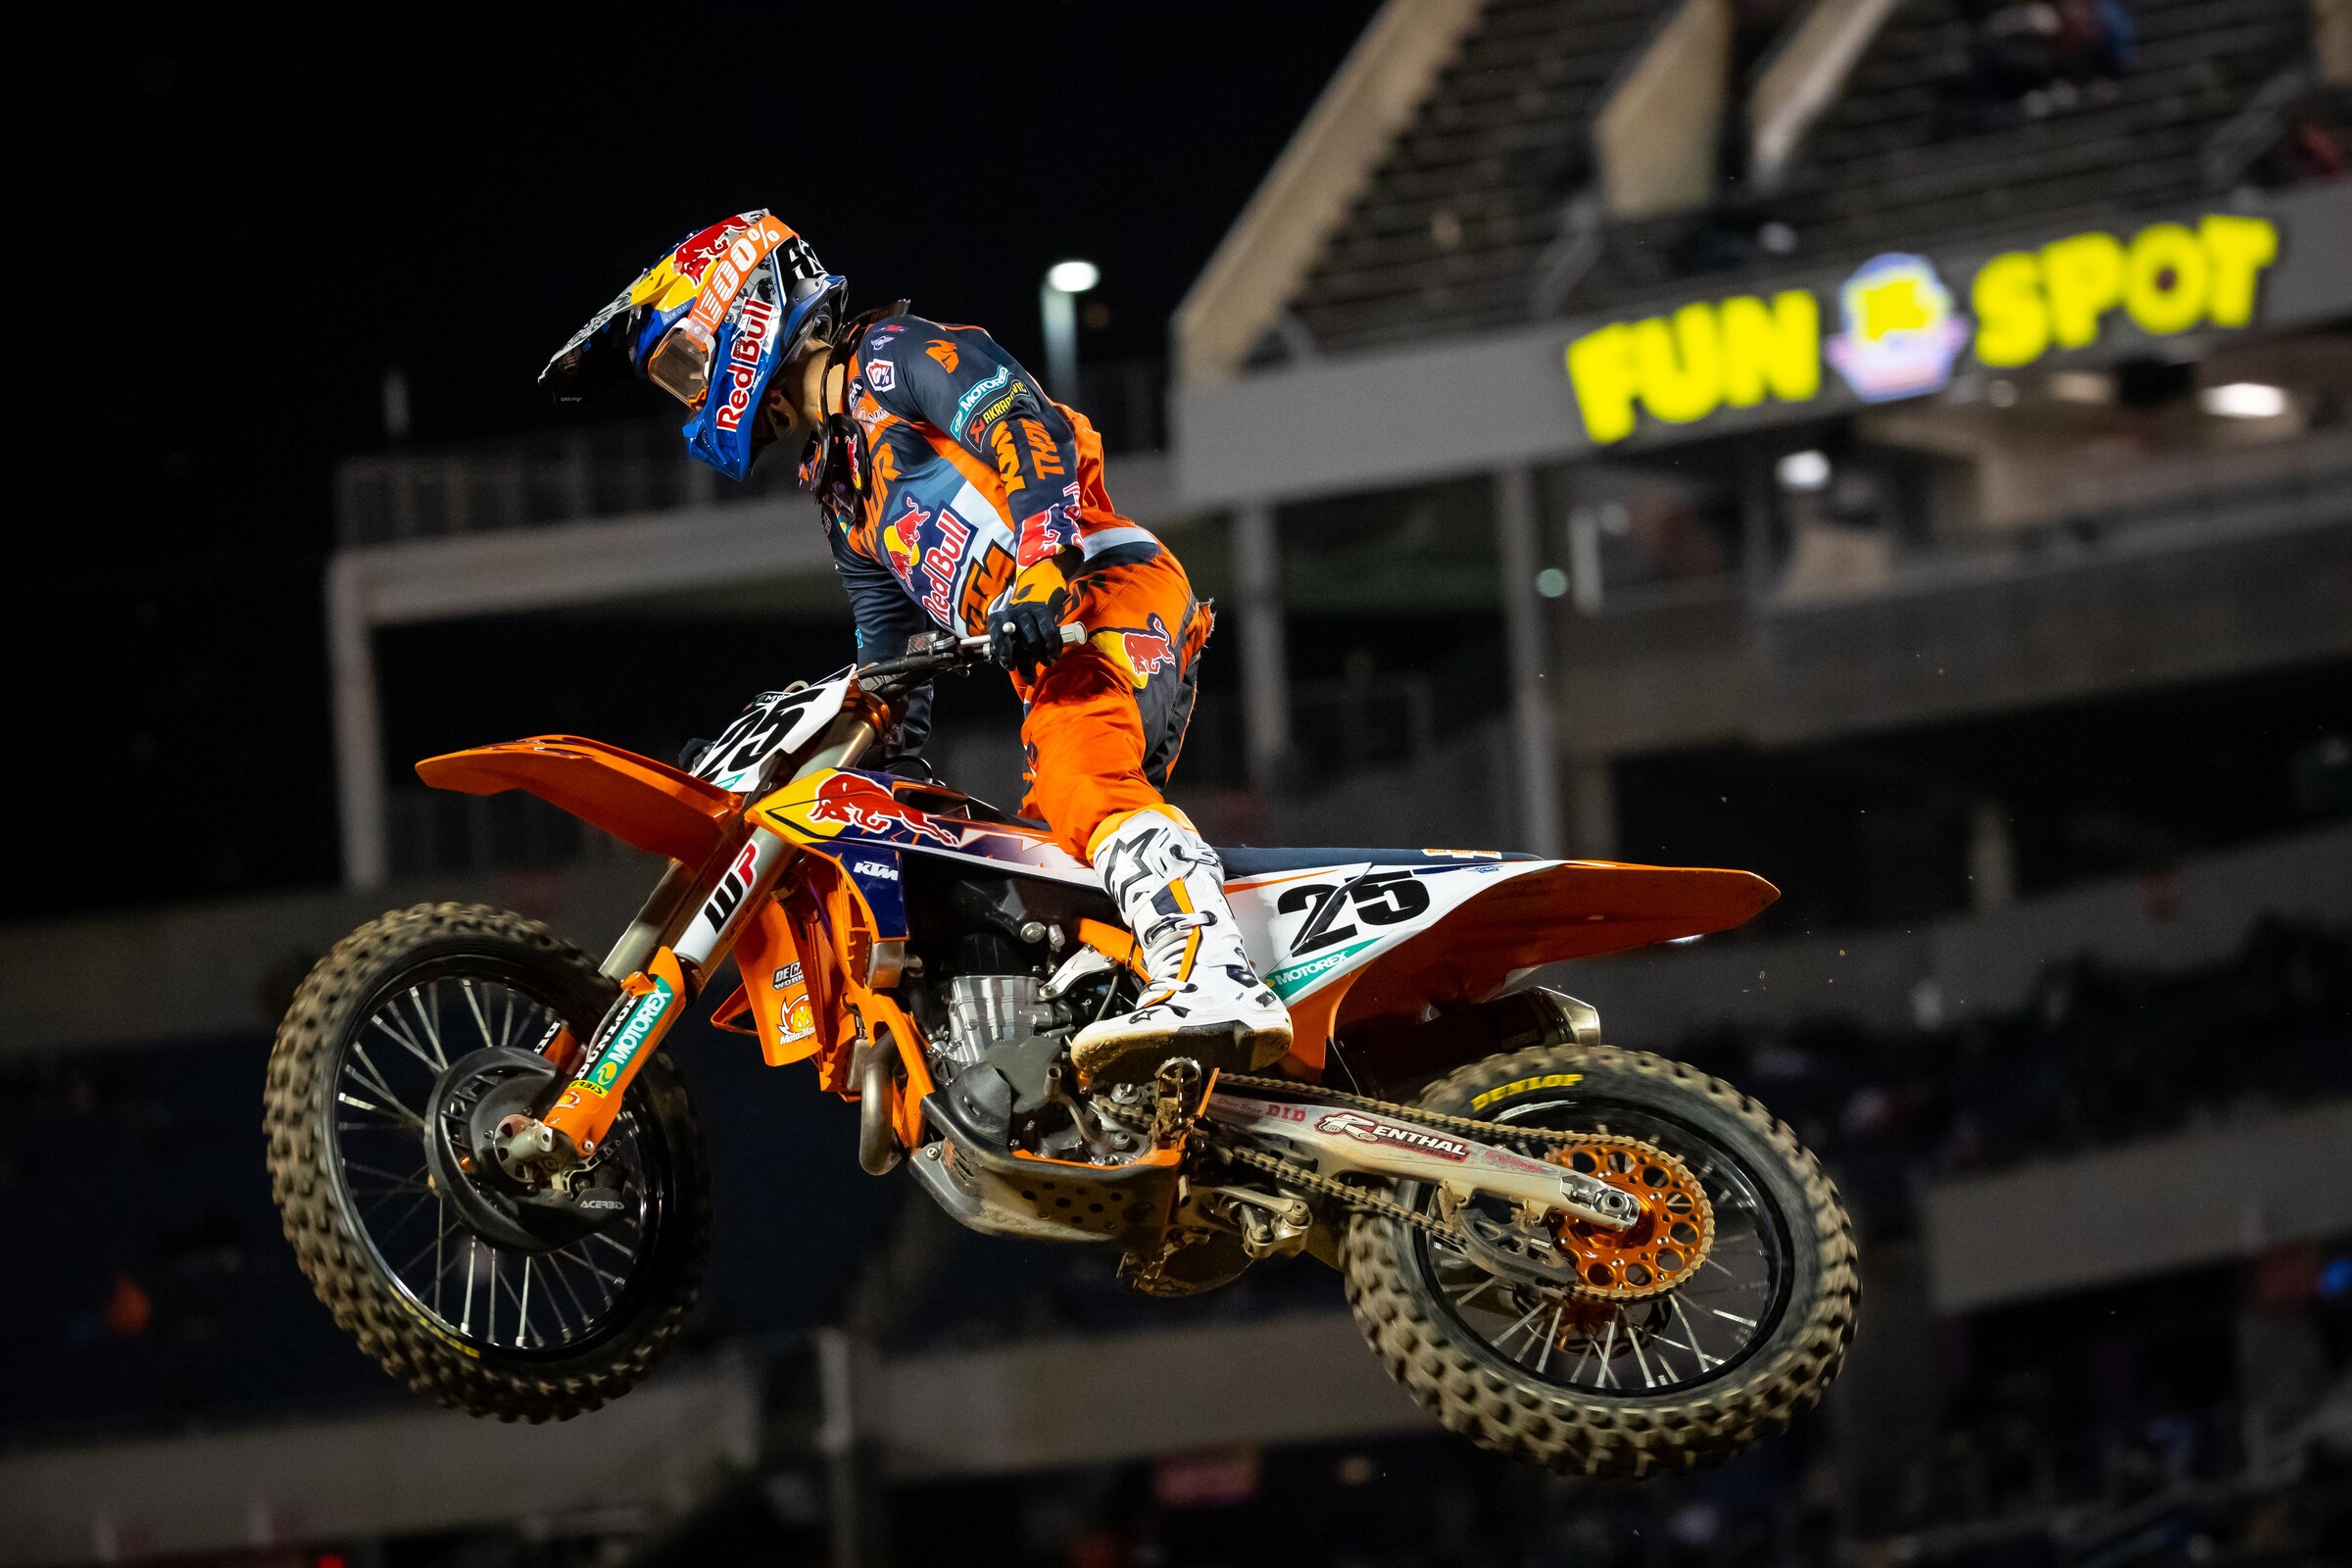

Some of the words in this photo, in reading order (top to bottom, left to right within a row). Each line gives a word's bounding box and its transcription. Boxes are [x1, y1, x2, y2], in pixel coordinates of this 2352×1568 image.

[694, 221, 781, 324] 100%
[663, 303, 688, 324] AIROH
[729, 296, 774, 366] Bull
[1568, 288, 1819, 444] FUN
[1972, 213, 2278, 369] SPOT
[715, 362, 758, 433] Red
[959, 367, 1009, 413] MOTORE
[924, 507, 971, 584] Bull
[696, 687, 827, 784] 25
[853, 859, 900, 882] KTM
[1277, 869, 1431, 958] 25
[1275, 949, 1349, 986] MOTOREX
[607, 986, 672, 1065] MOTOREX
[1318, 1113, 1467, 1156] RENTHAL
